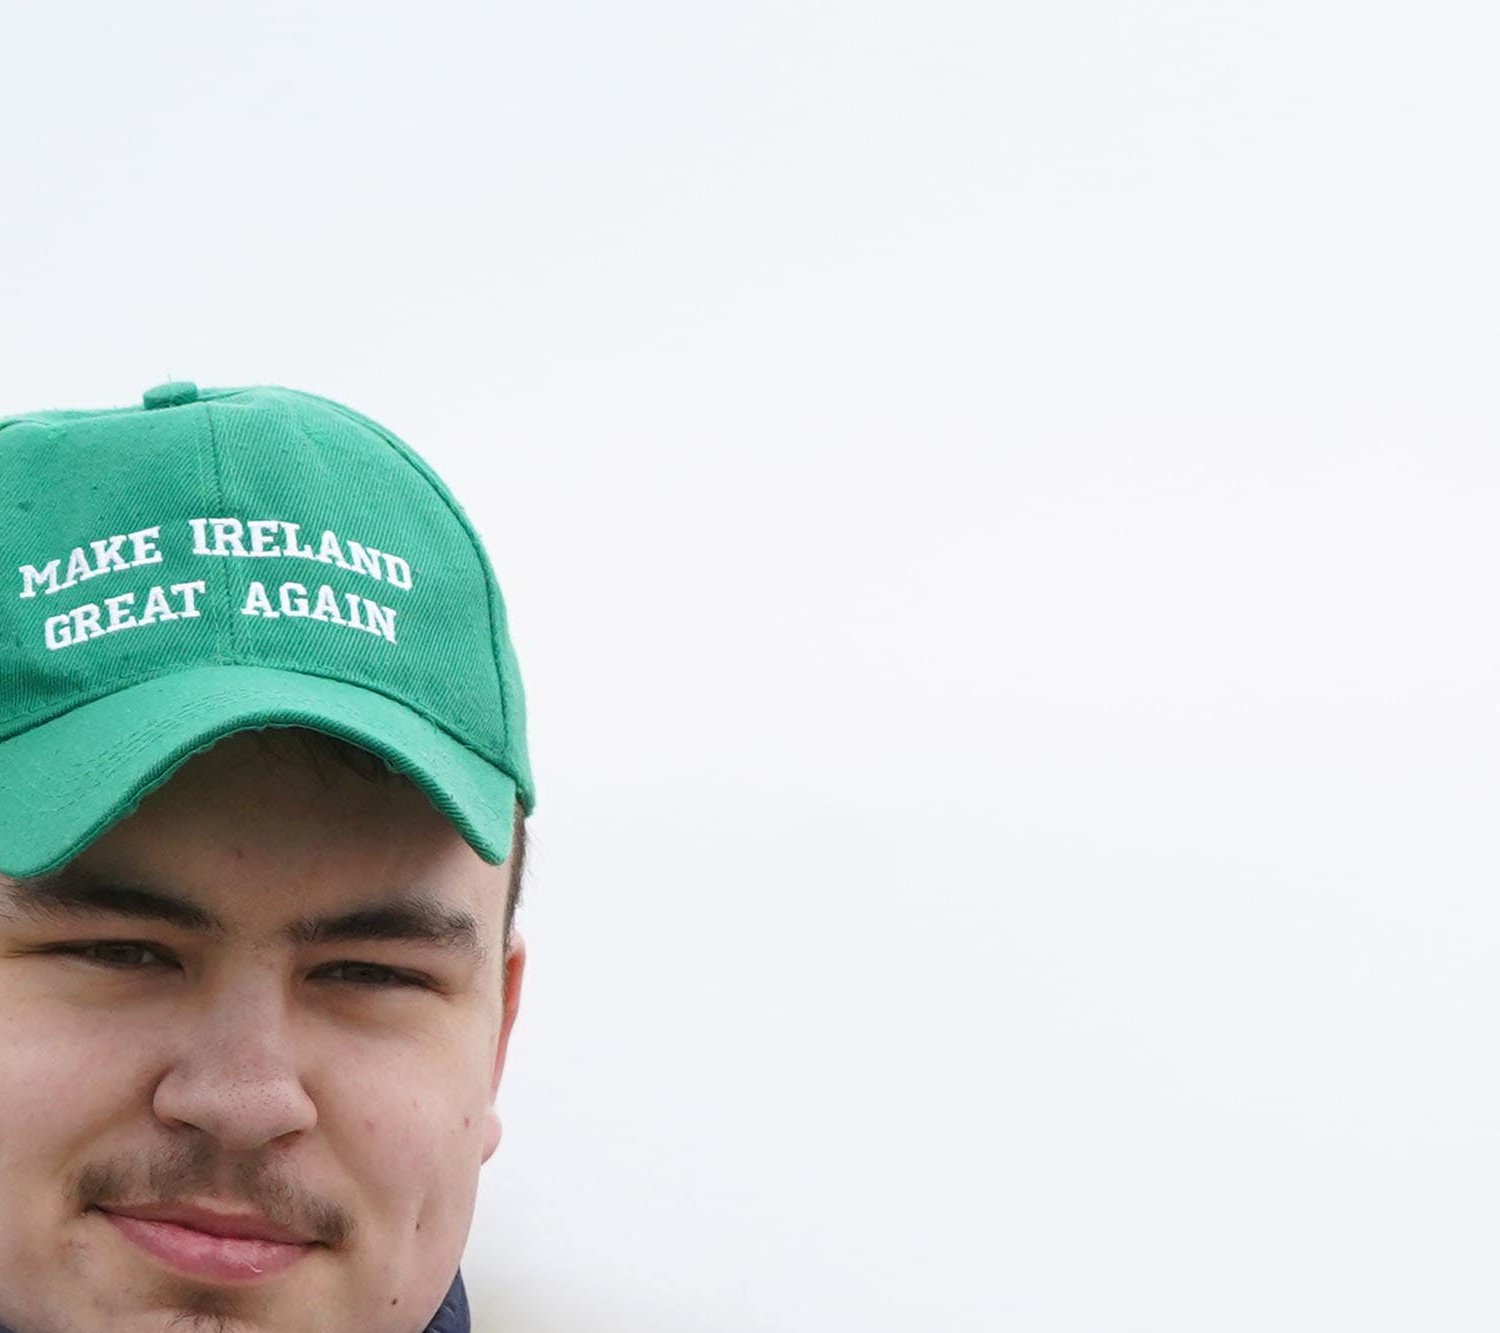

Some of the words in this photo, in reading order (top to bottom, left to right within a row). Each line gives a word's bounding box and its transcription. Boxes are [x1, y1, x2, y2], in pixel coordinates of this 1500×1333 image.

[18, 525, 164, 599] MAKE
[188, 517, 413, 592] IRELAND
[44, 580, 206, 651] GREAT
[241, 582, 398, 645] AGAIN
